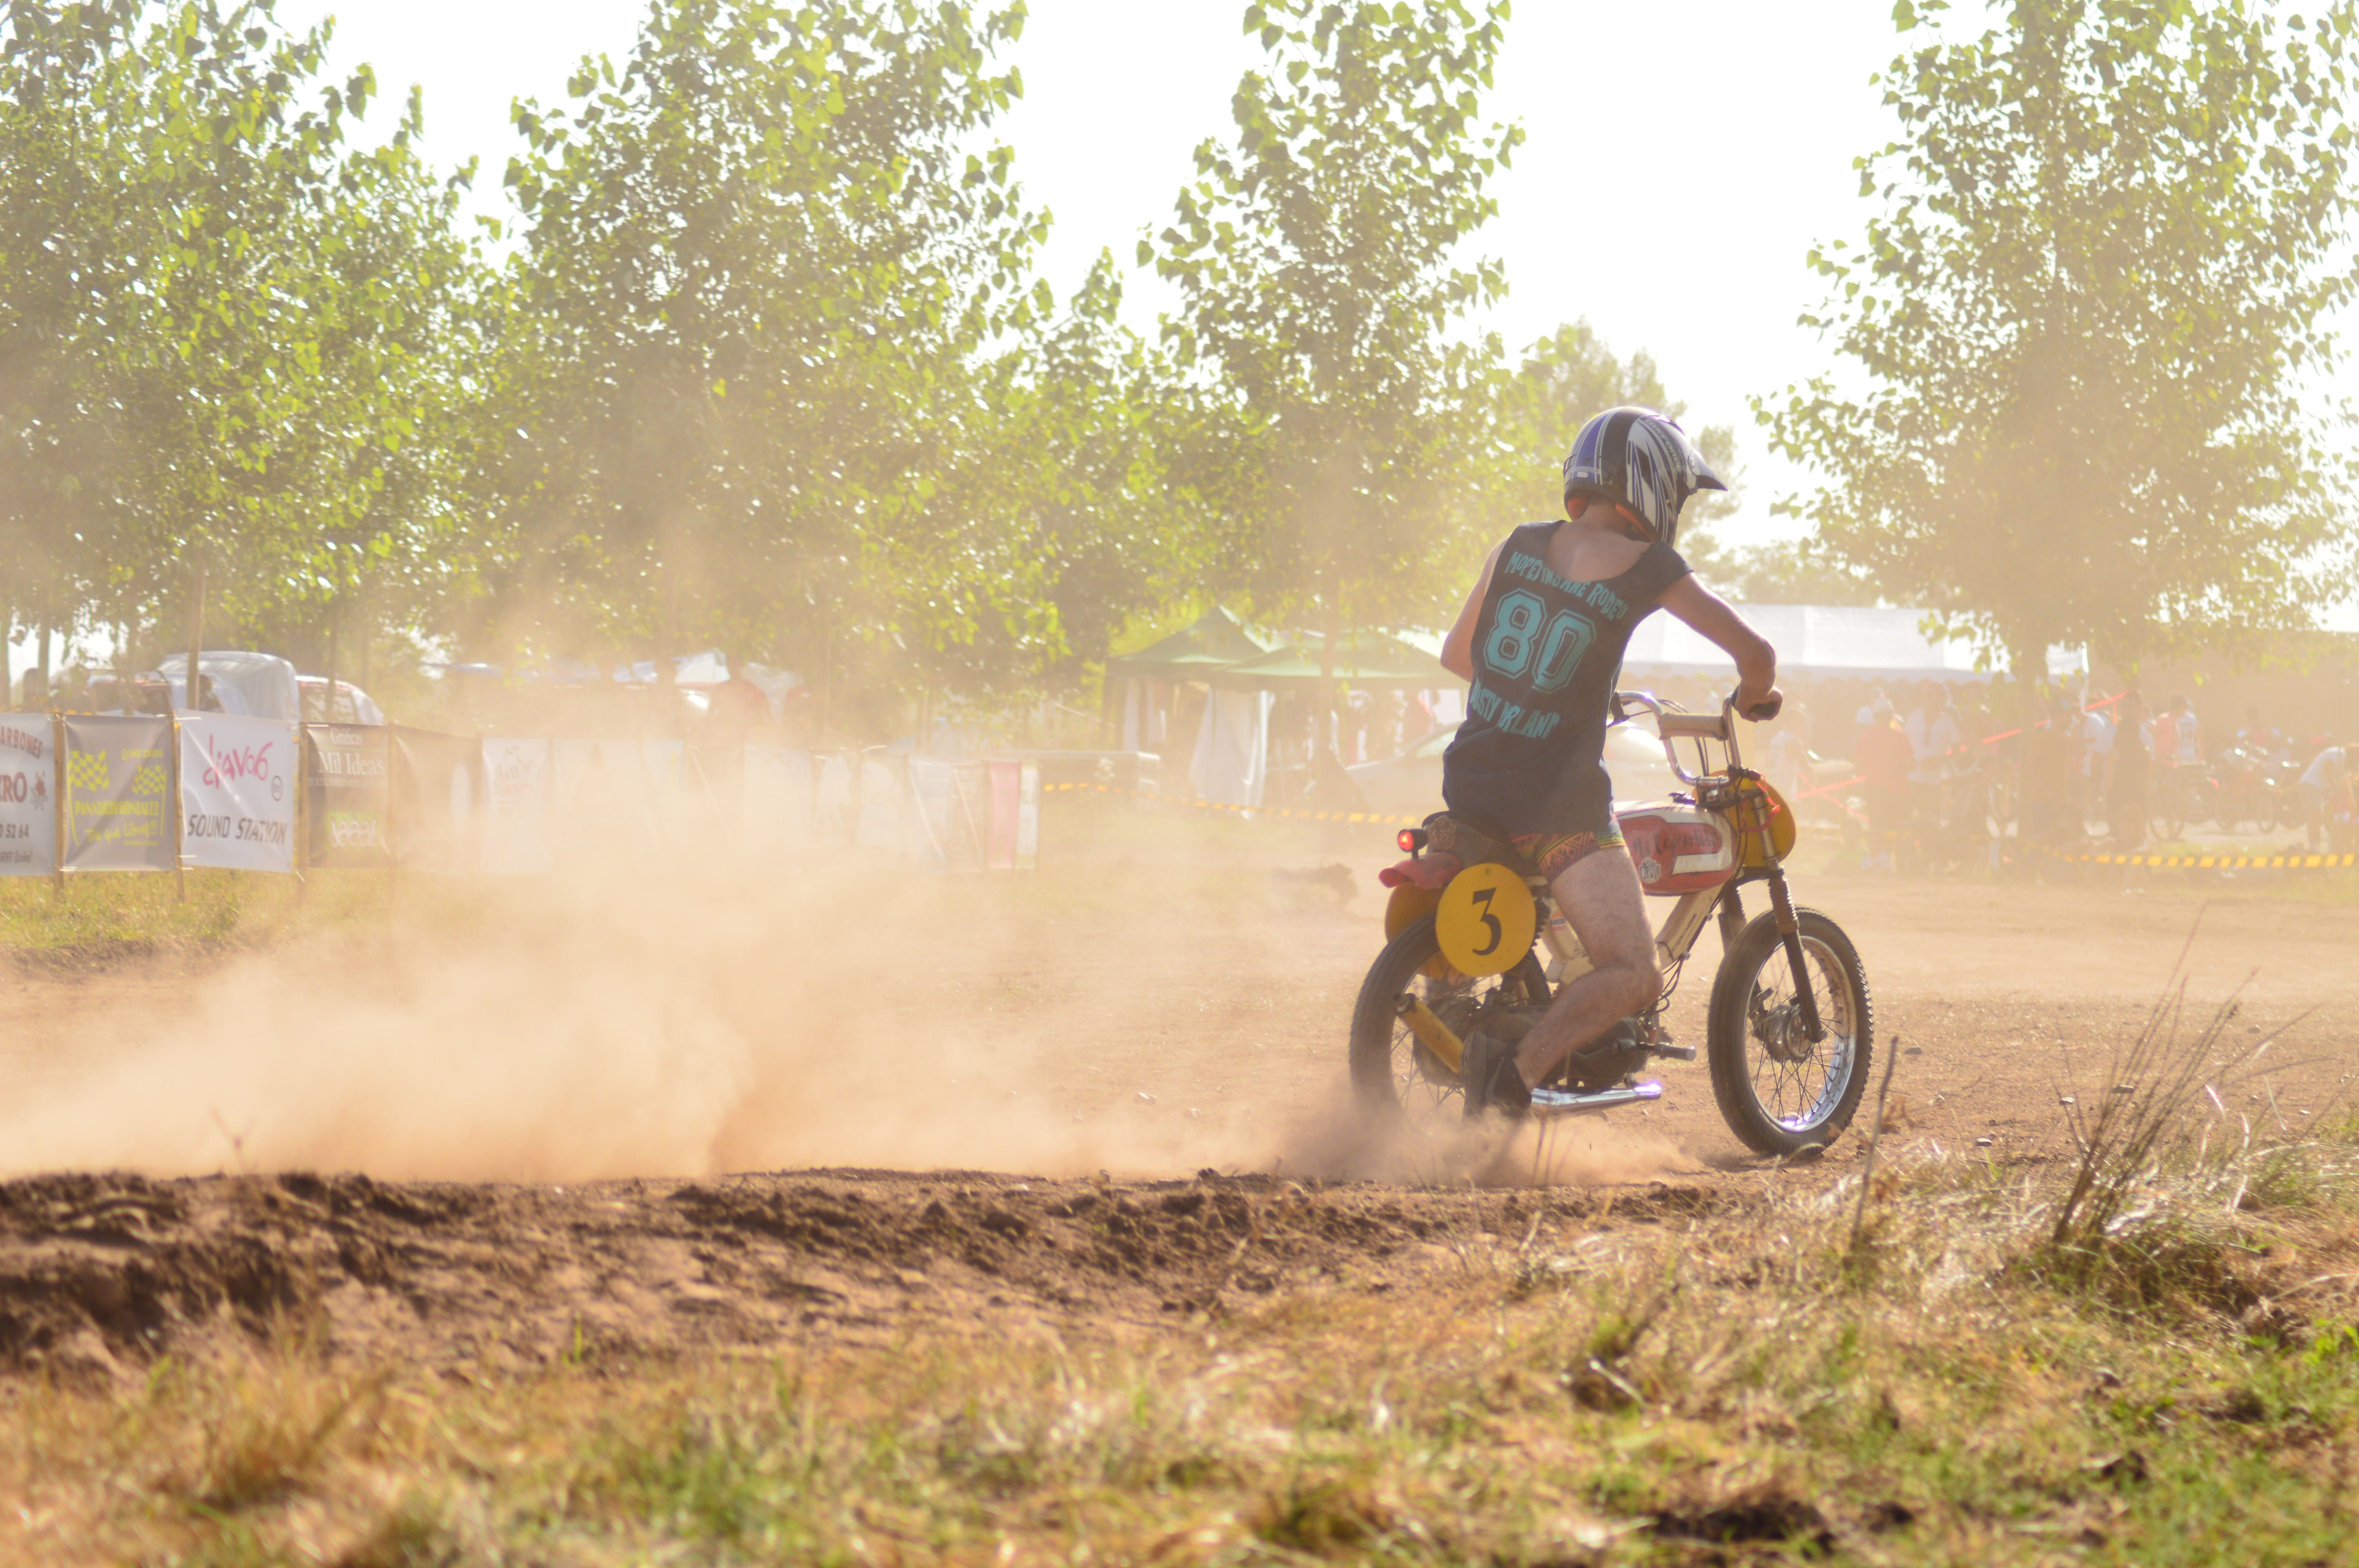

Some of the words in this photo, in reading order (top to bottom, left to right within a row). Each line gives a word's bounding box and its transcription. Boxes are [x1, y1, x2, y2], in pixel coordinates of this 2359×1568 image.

[1585, 583, 1628, 621] RODEO
[1484, 588, 1596, 694] 80
[317, 751, 342, 774] Mil
[344, 752, 386, 776] Ideas
[5, 824, 16, 839] 52
[18, 824, 29, 838] 64
[188, 814, 231, 838] SOUND
[235, 818, 287, 845] STATION
[1472, 887, 1501, 956] 3
